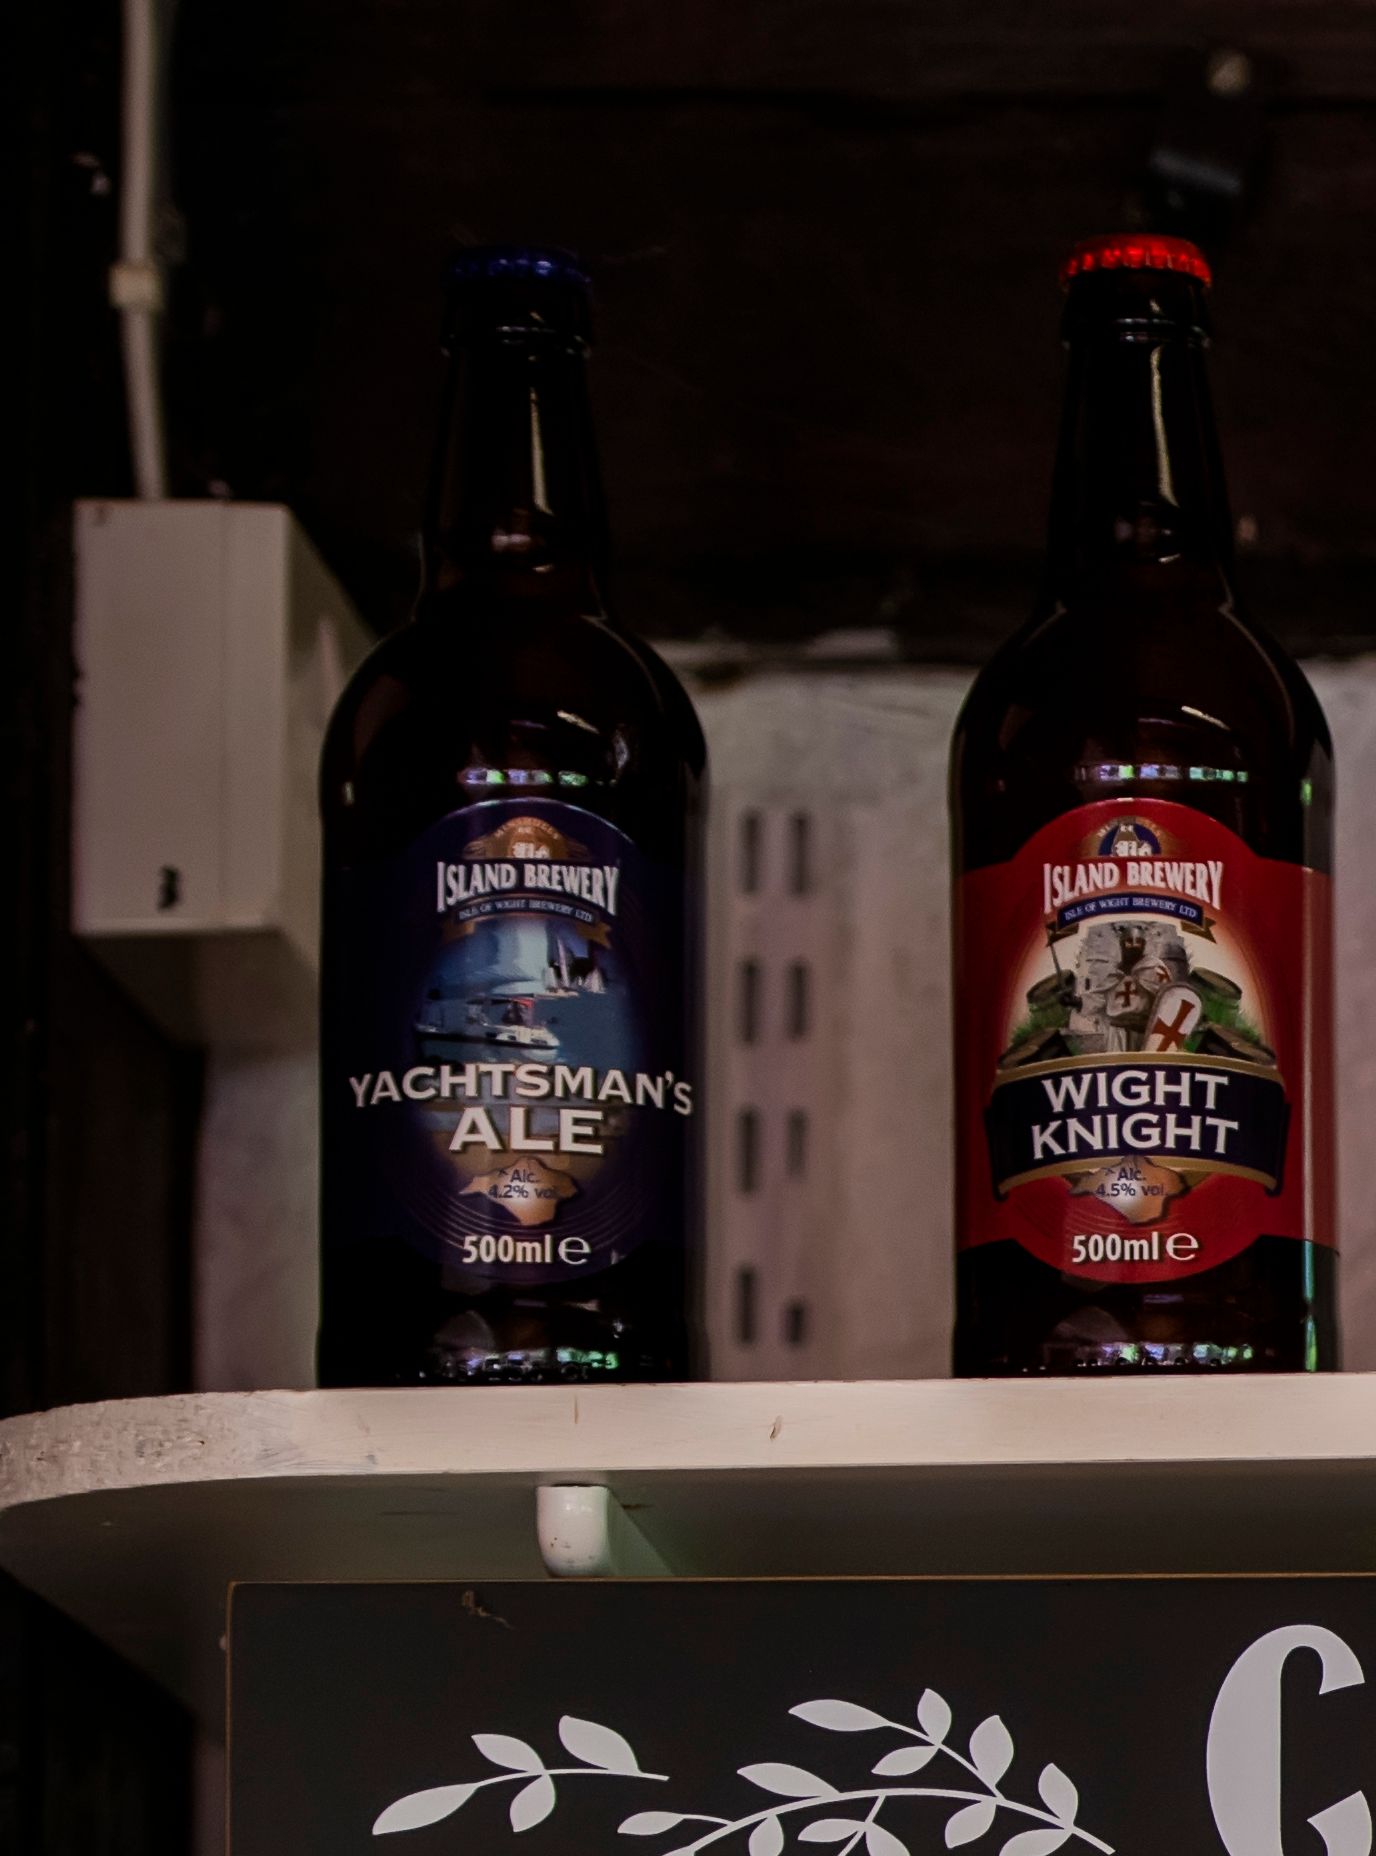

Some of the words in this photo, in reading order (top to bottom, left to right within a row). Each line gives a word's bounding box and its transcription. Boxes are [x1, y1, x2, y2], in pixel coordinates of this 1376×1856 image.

[437, 861, 517, 913] ISLAND
[524, 863, 620, 915] BREWERY
[1043, 862, 1120, 915] ISLAND
[1126, 860, 1224, 911] BREWERY
[1064, 908, 1083, 921] ISLE
[1085, 903, 1097, 913] OF
[1099, 897, 1130, 909] WIGHT
[1132, 897, 1177, 912] BREWERY
[1179, 904, 1198, 918] LTD
[348, 1062, 694, 1117] YACHTSMAN'S
[1041, 1068, 1231, 1113] WIGHT
[448, 1107, 605, 1155] ALE
[1031, 1111, 1239, 1160] KNIGHT
[510, 1169, 540, 1183] Alc.
[1095, 1182, 1136, 1197] 4.5%
[1117, 1167, 1146, 1182] Alc.
